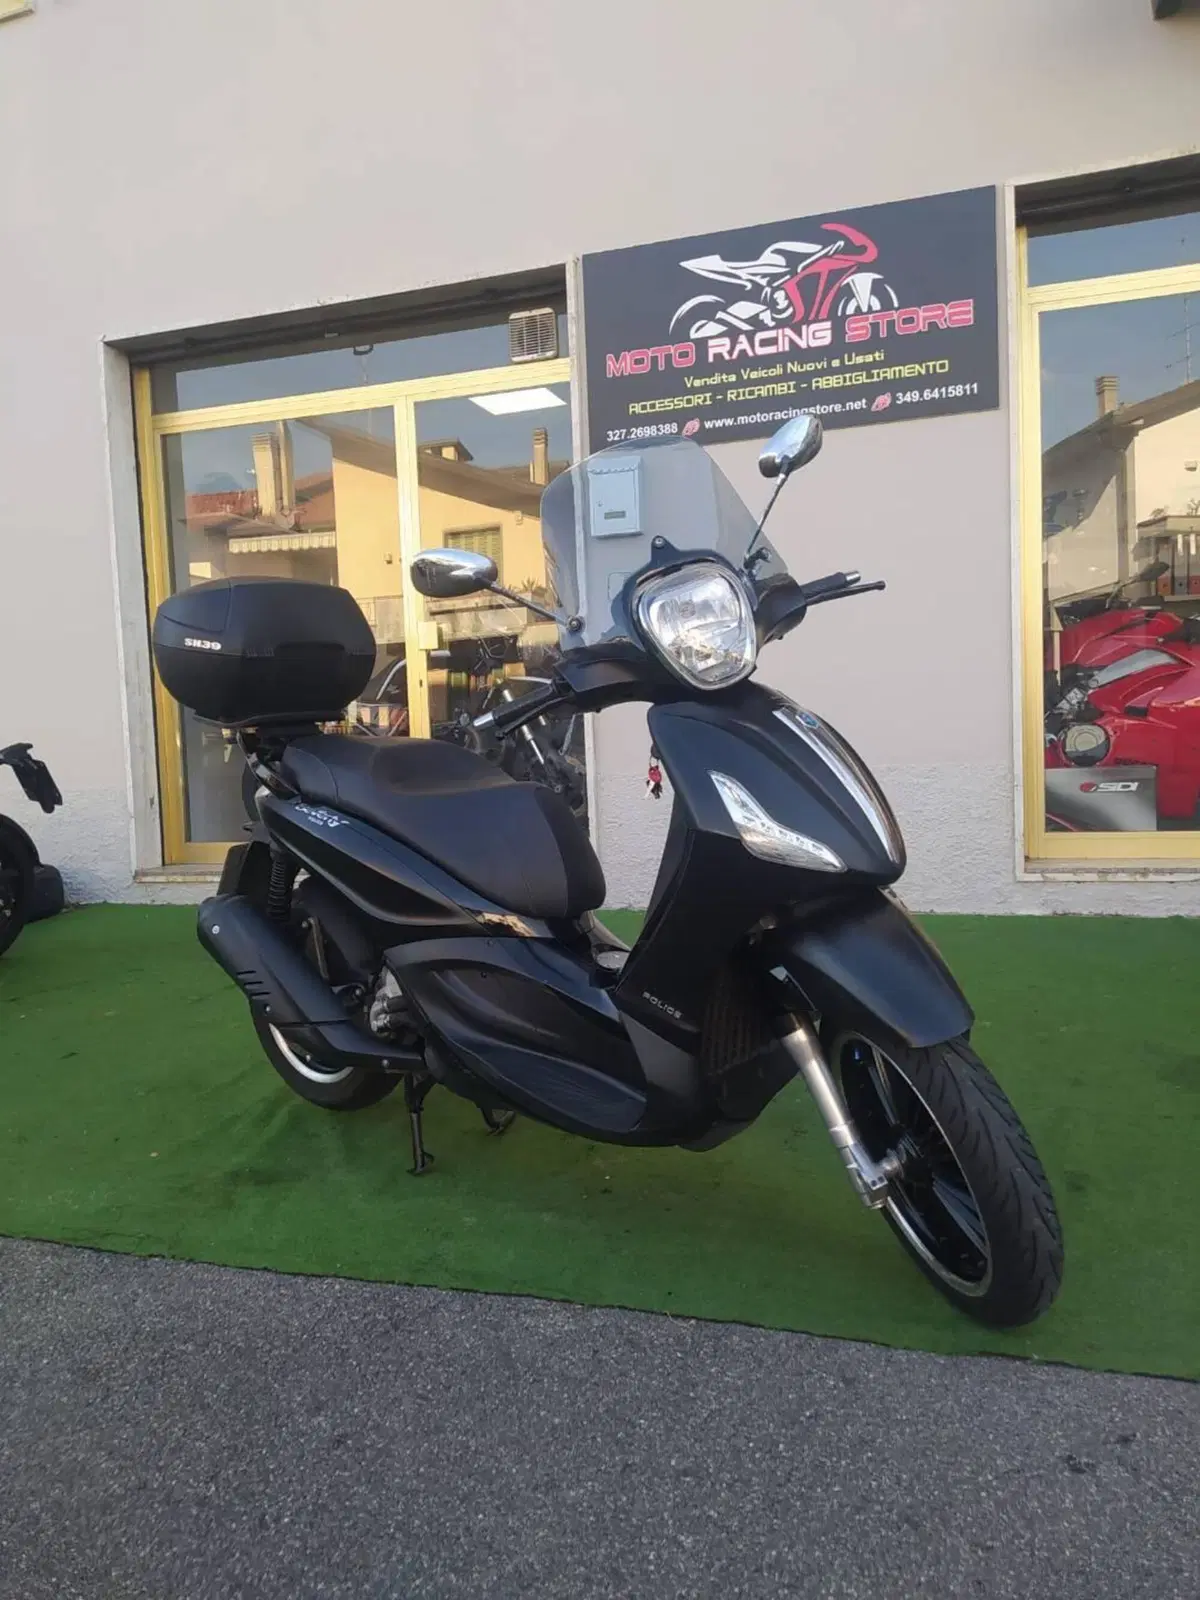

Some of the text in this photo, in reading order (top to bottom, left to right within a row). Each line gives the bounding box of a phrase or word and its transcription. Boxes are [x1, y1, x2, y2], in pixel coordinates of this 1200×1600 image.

[606, 299, 974, 378] MOTO RACING STORE
[629, 392, 712, 415] ACCESSORI
[727, 381, 796, 402] RICAMBI
[812, 360, 949, 390] ABBIGLIAMENTO
[684, 349, 885, 388] Vendita Veicoli Nuovi e Usati
[606, 422, 678, 442] 327.2698388
[896, 383, 979, 405] 349.6415811
